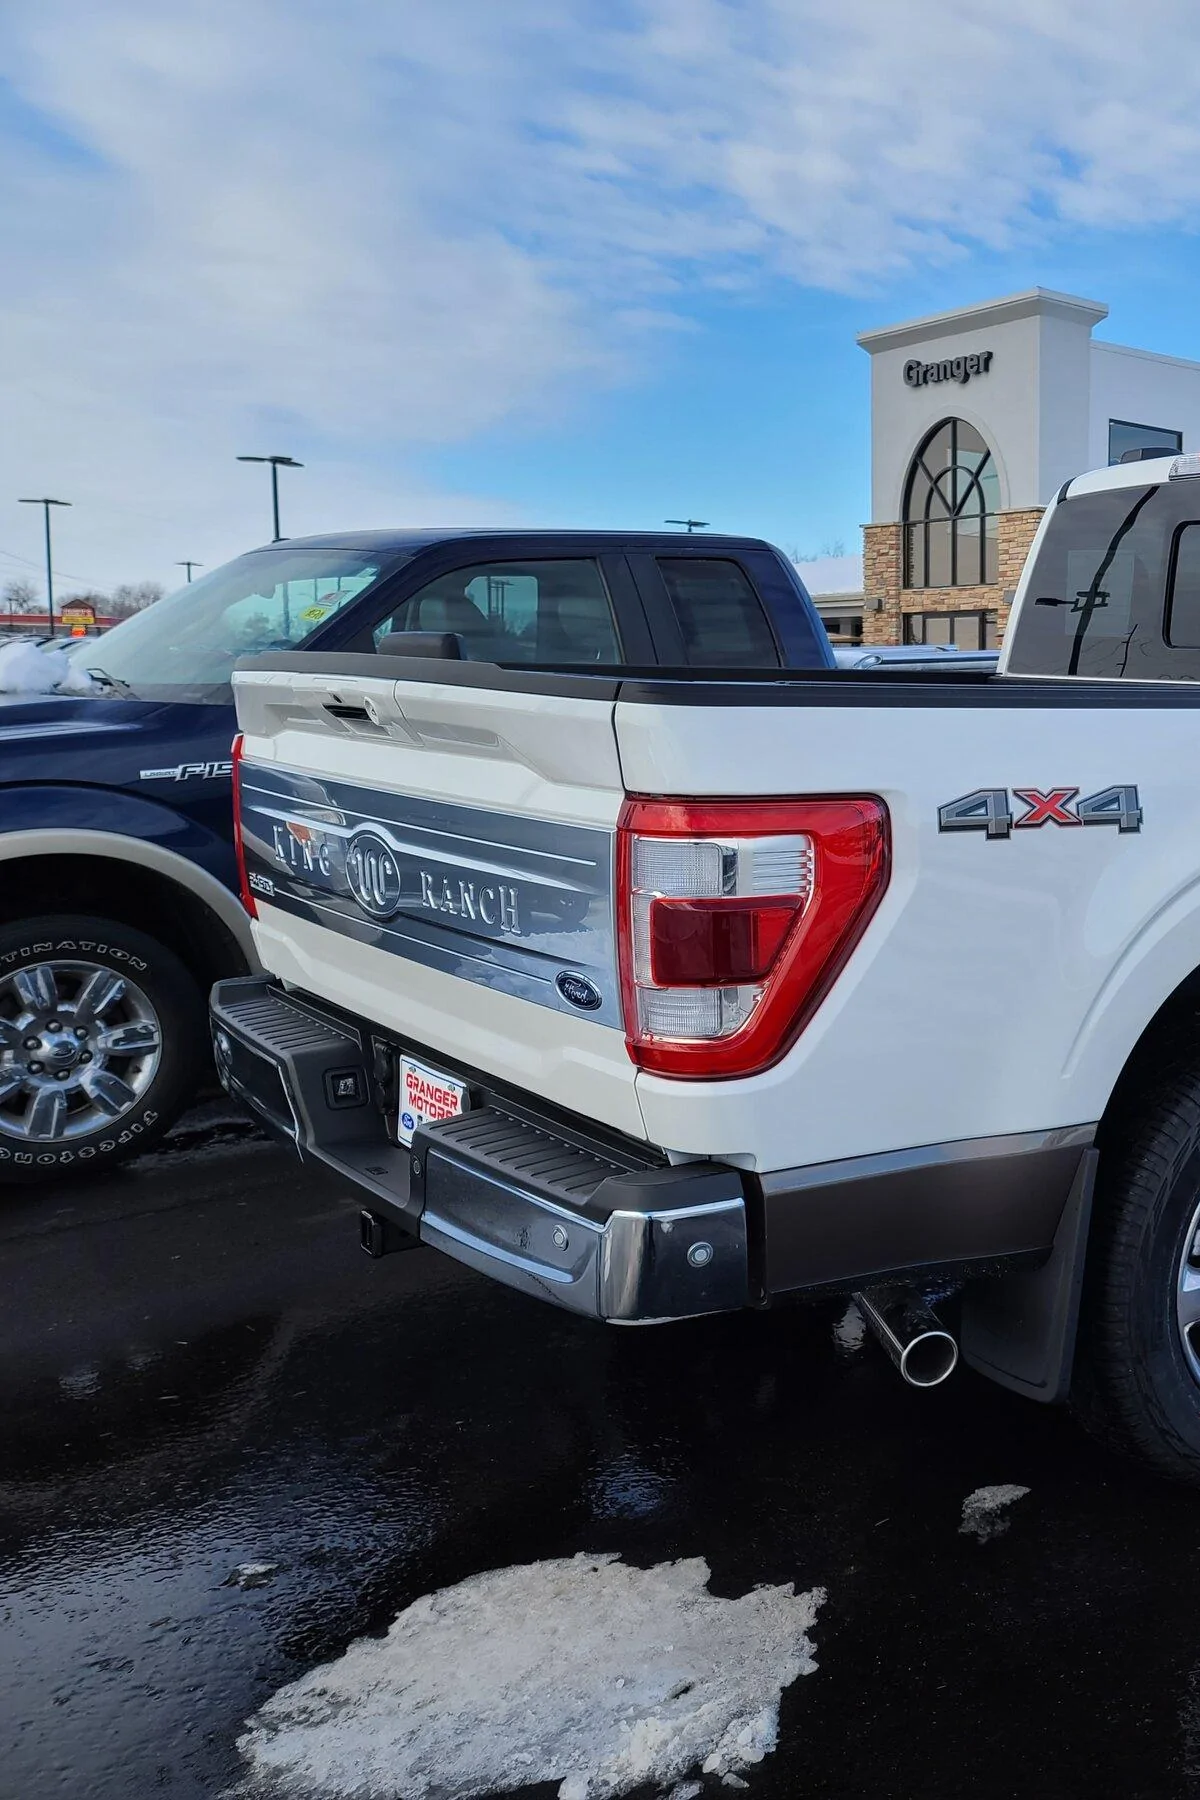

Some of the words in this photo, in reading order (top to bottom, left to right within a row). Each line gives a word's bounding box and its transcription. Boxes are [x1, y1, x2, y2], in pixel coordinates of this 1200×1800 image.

[903, 351, 993, 387] Granger
[272, 825, 331, 876] KING
[420, 870, 522, 934] RANCH
[1, 940, 148, 971] TINATION
[406, 1073, 458, 1110] GRANGER
